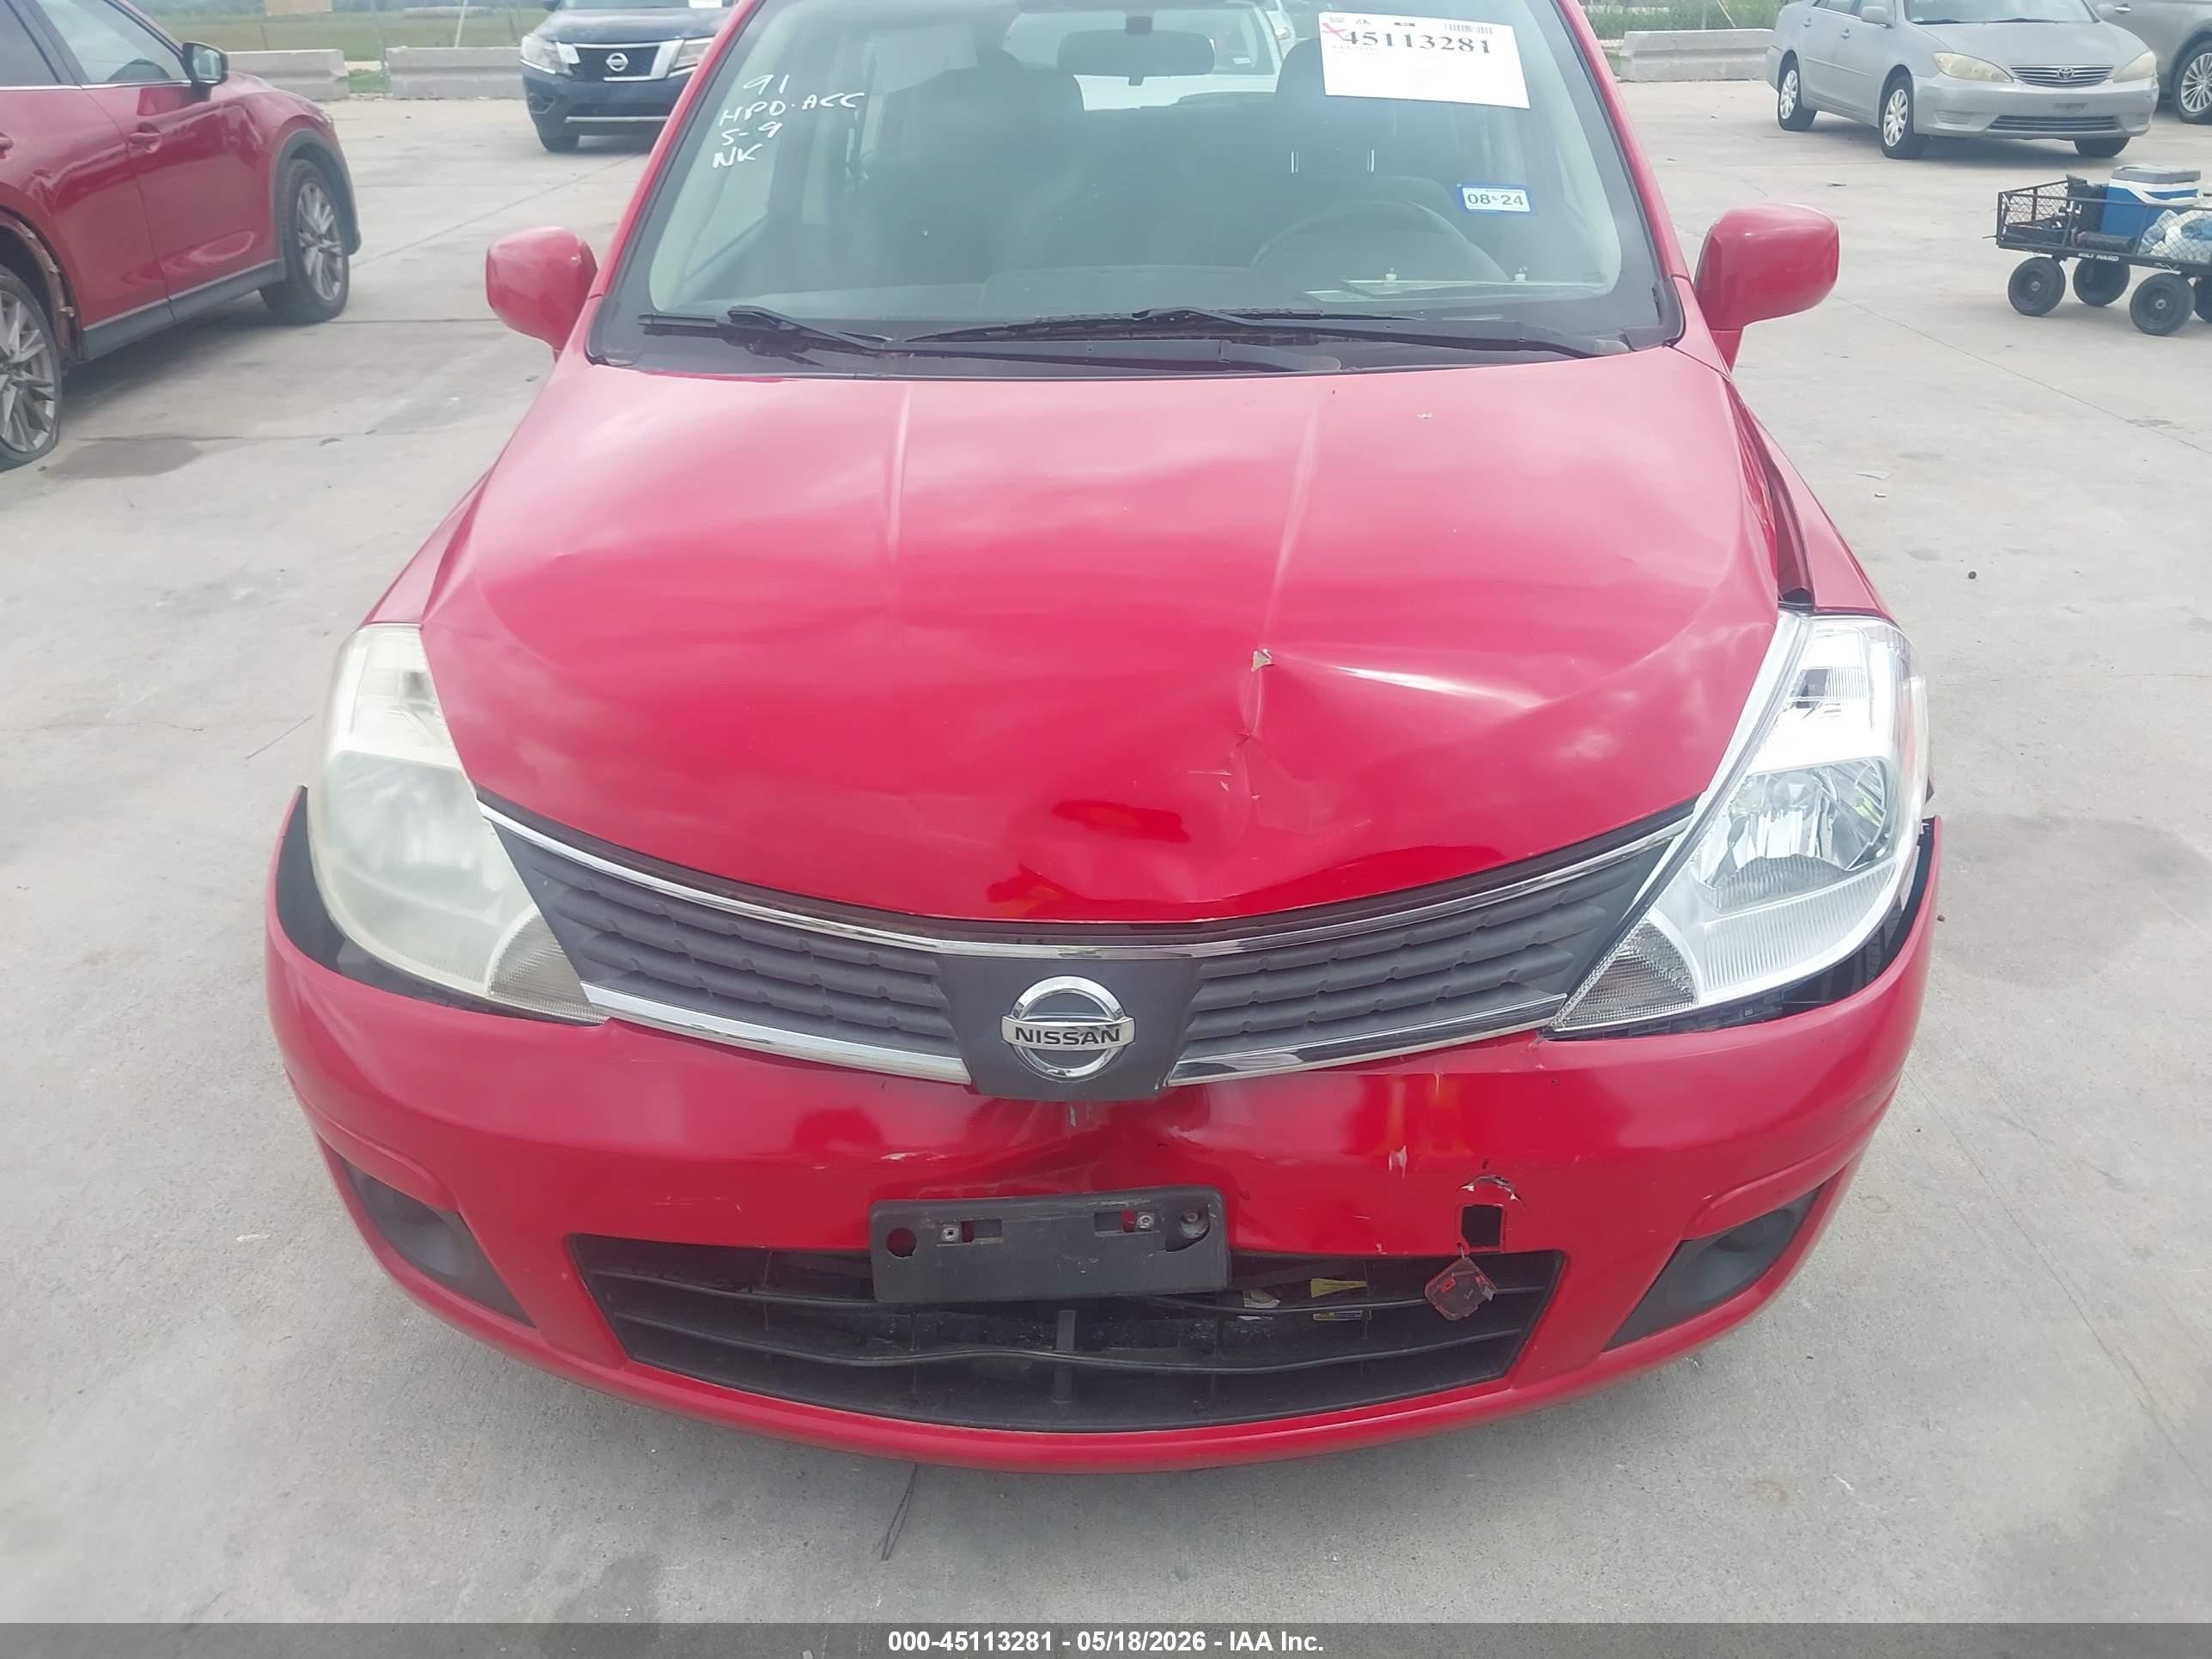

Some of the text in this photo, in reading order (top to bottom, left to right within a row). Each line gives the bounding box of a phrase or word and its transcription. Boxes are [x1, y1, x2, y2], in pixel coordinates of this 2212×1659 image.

[1343, 31, 1490, 53] 45113281
[712, 143, 763, 168] NK
[1015, 1026, 1121, 1046] NISSAN
